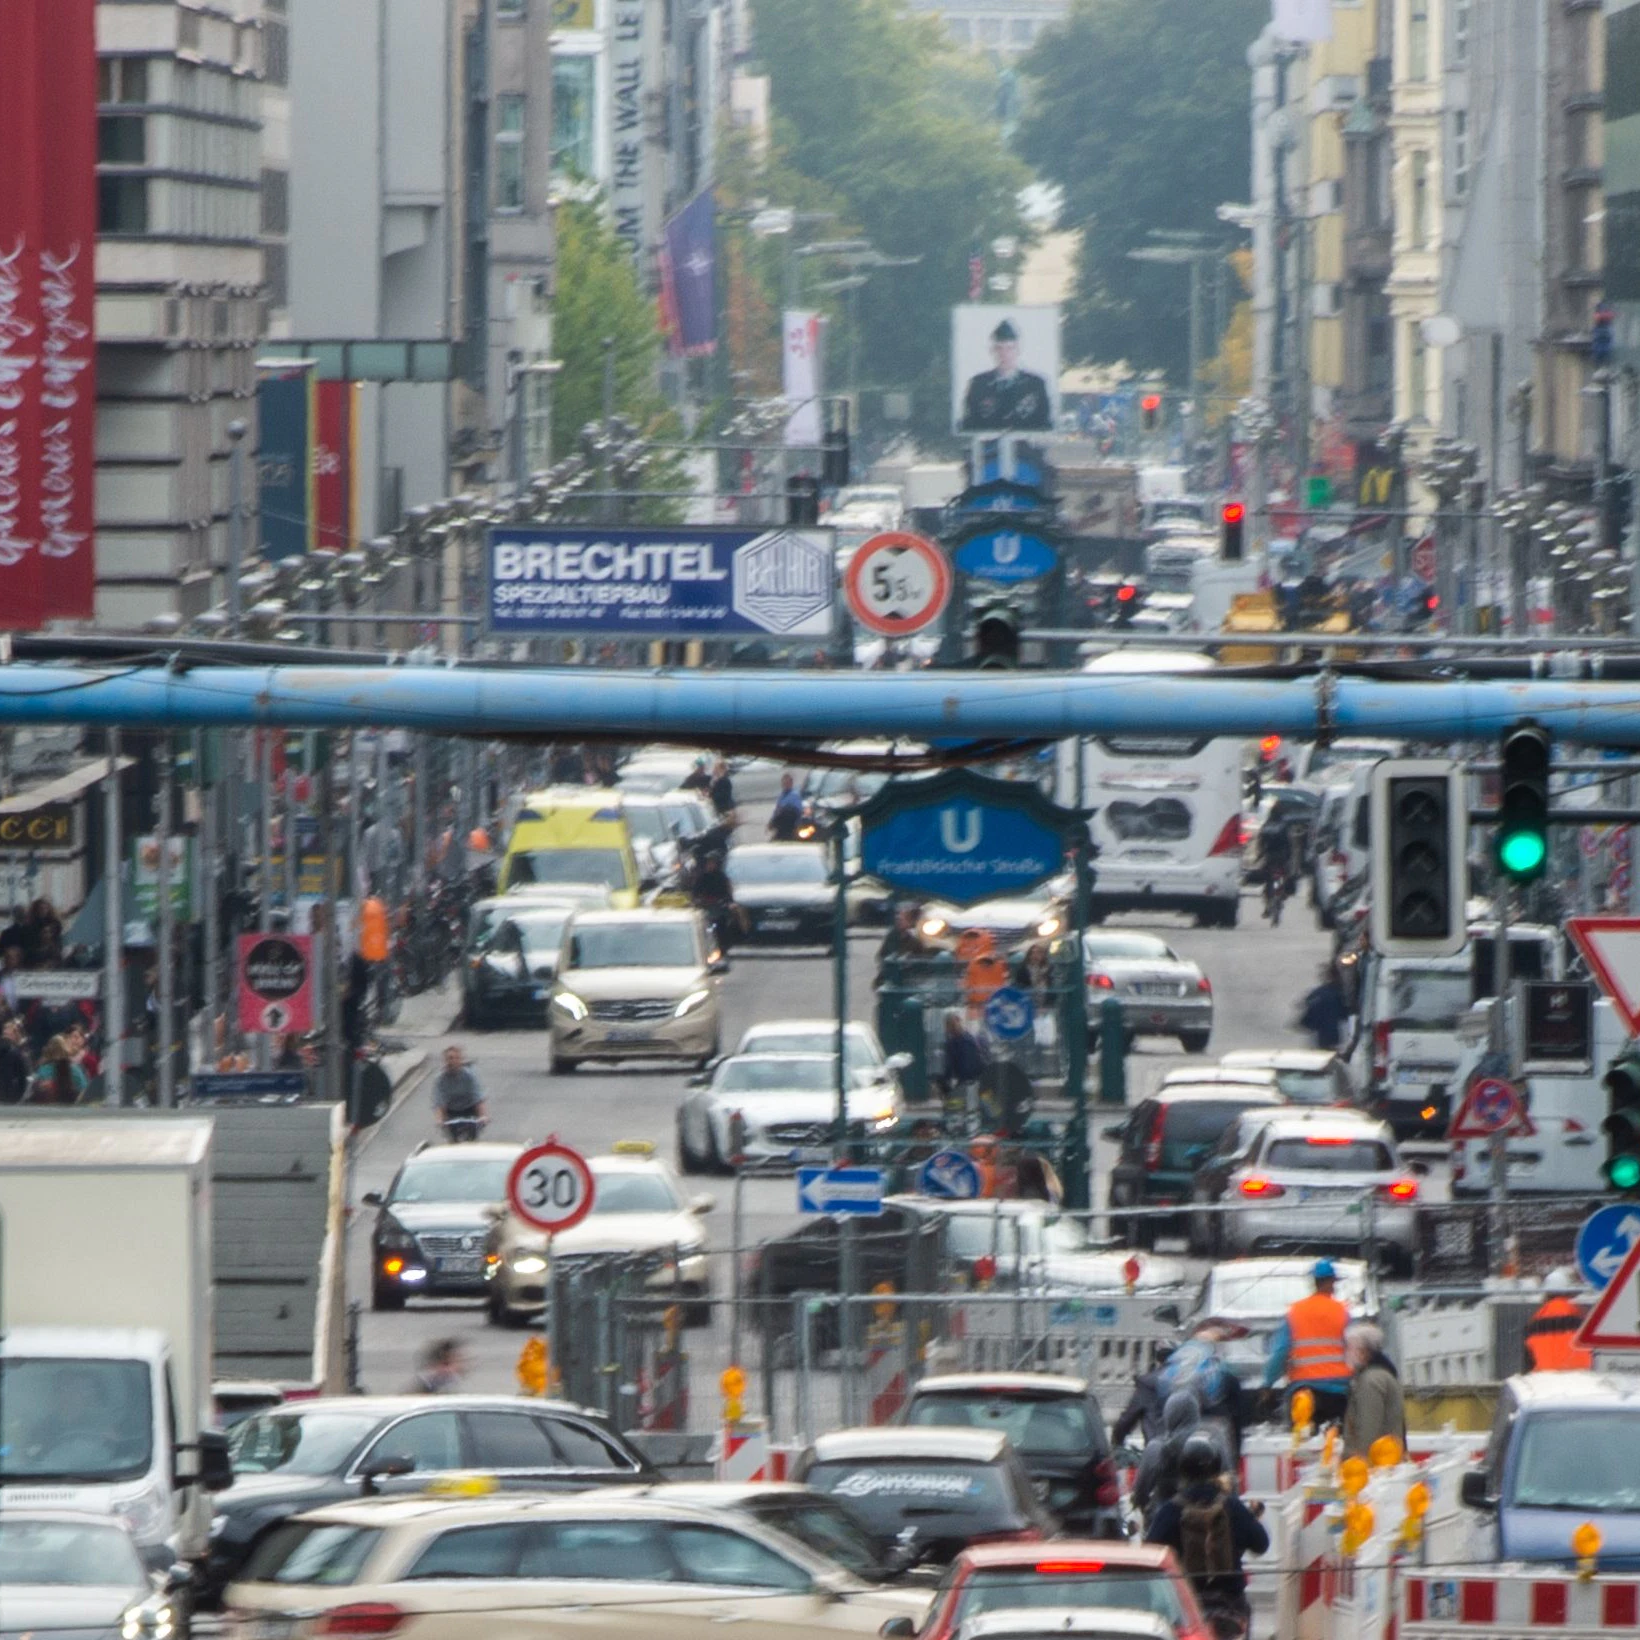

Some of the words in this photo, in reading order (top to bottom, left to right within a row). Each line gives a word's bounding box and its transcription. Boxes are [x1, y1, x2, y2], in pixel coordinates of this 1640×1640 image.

[492, 542, 729, 582] BRECHTEL
[992, 533, 1022, 564] U
[939, 807, 983, 854] U
[523, 1168, 577, 1209] 30
